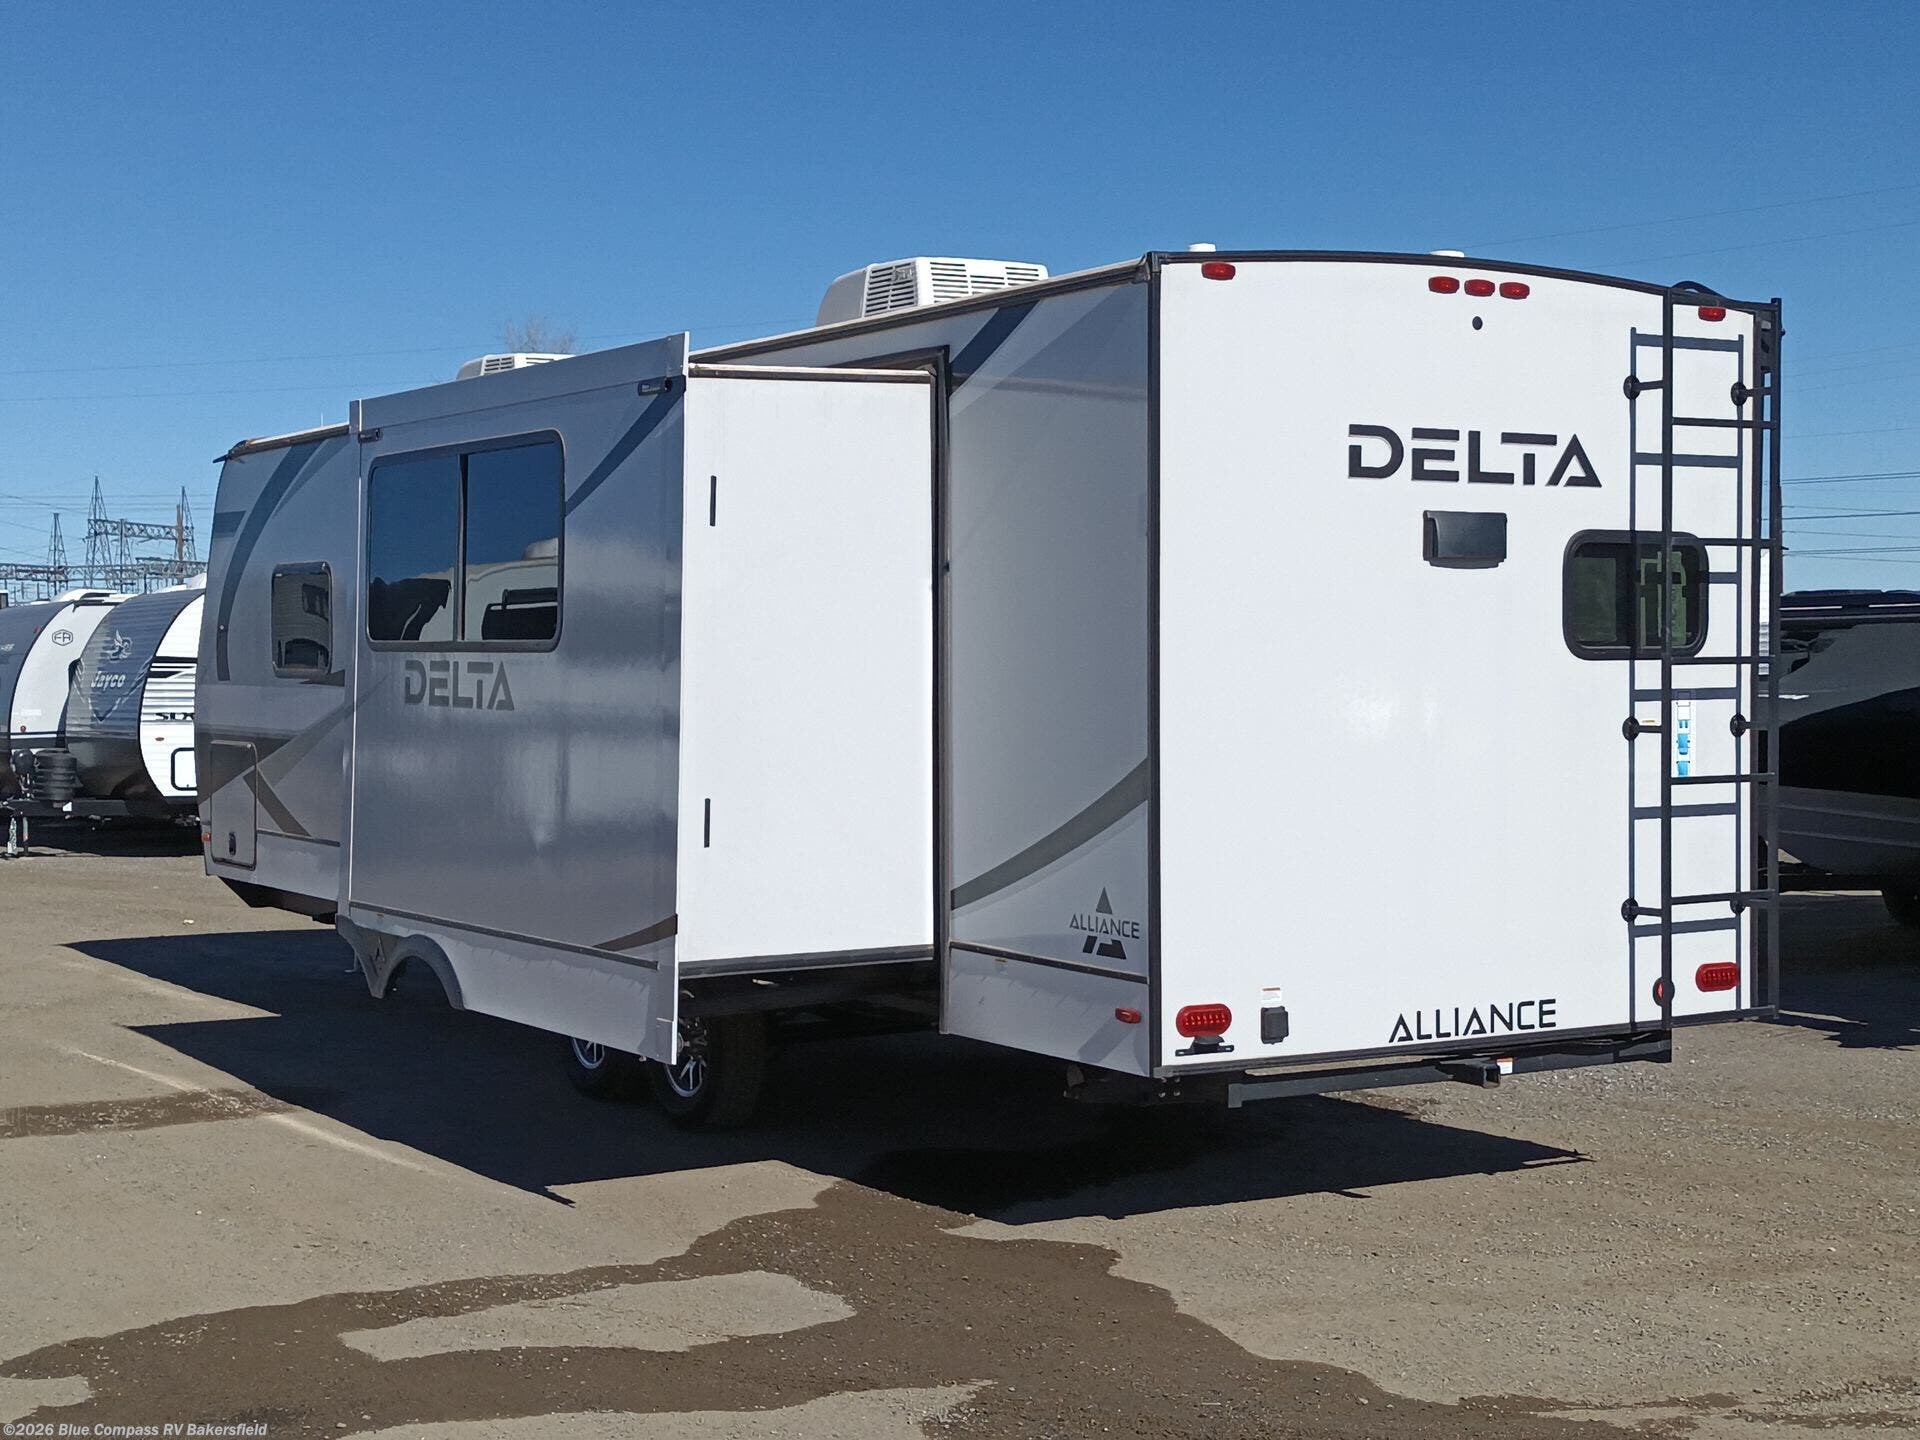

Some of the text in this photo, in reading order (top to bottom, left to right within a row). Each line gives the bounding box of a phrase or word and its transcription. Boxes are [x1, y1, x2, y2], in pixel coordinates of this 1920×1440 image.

[1348, 423, 1602, 487] DELTA
[91, 670, 126, 691] Jayco
[404, 659, 515, 711] DELTA
[1069, 913, 1140, 939] ALLIANCE
[1388, 998, 1557, 1044] ALLIANCE
